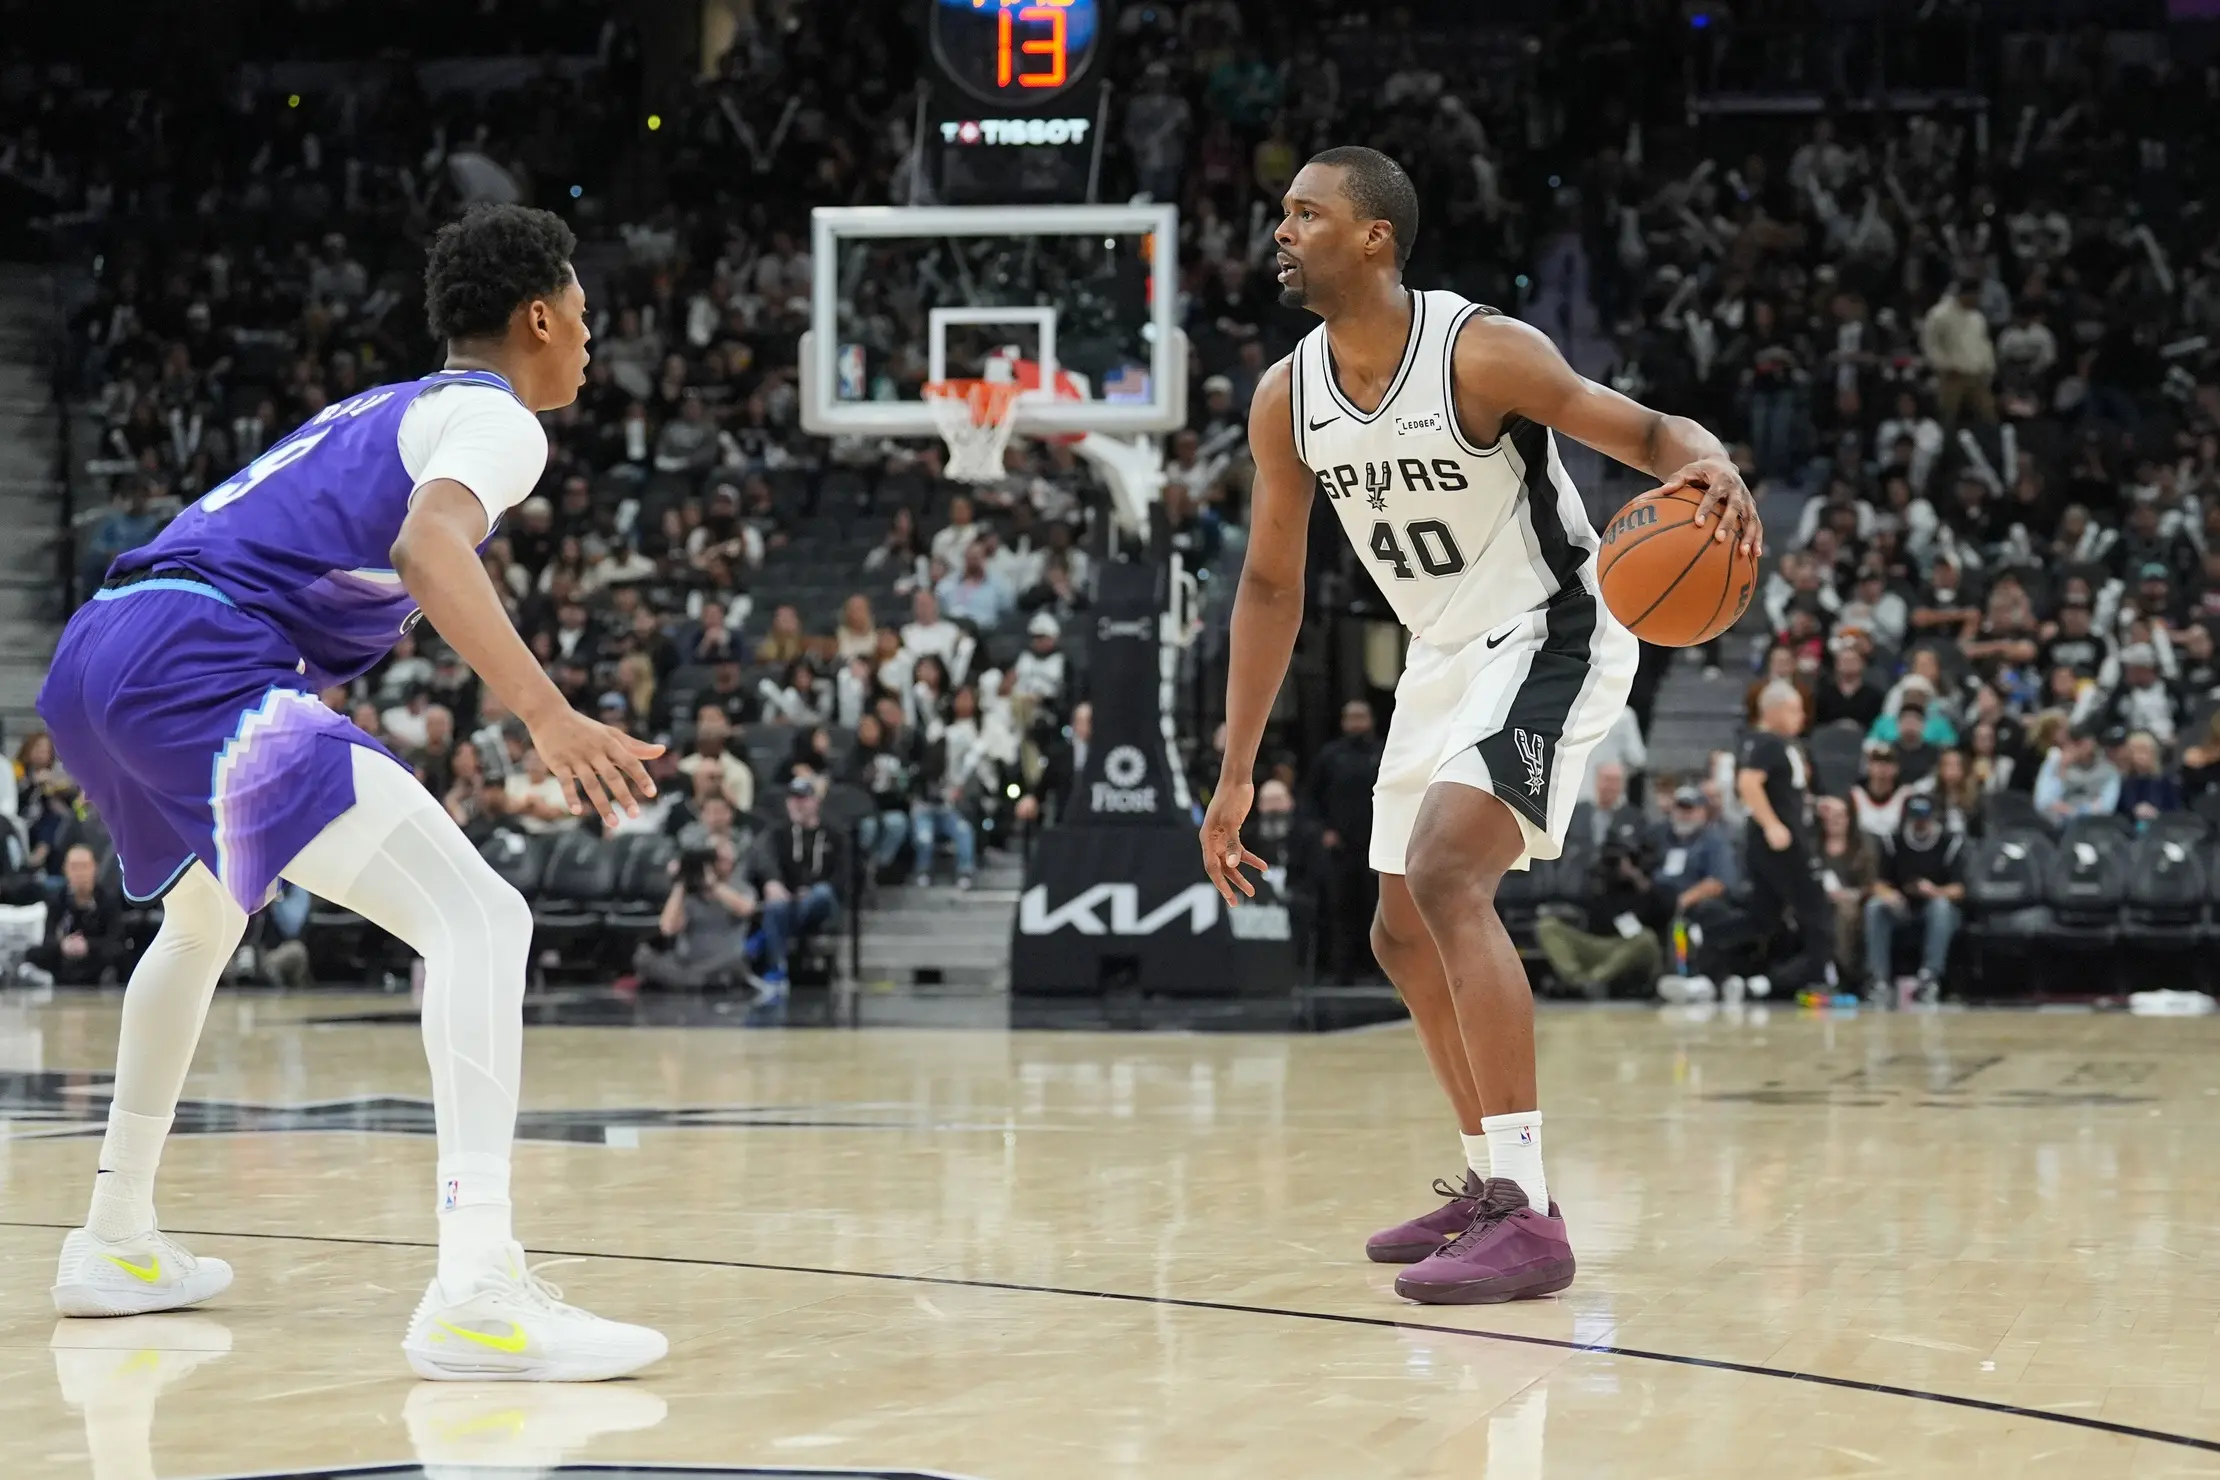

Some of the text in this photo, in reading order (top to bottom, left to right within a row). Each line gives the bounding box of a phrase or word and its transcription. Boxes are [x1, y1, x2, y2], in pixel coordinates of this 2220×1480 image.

[998, 7, 1067, 88] 13
[1402, 418, 1435, 430] LEDGER
[1316, 458, 1469, 512] SPURS
[1367, 517, 1469, 581] 40
